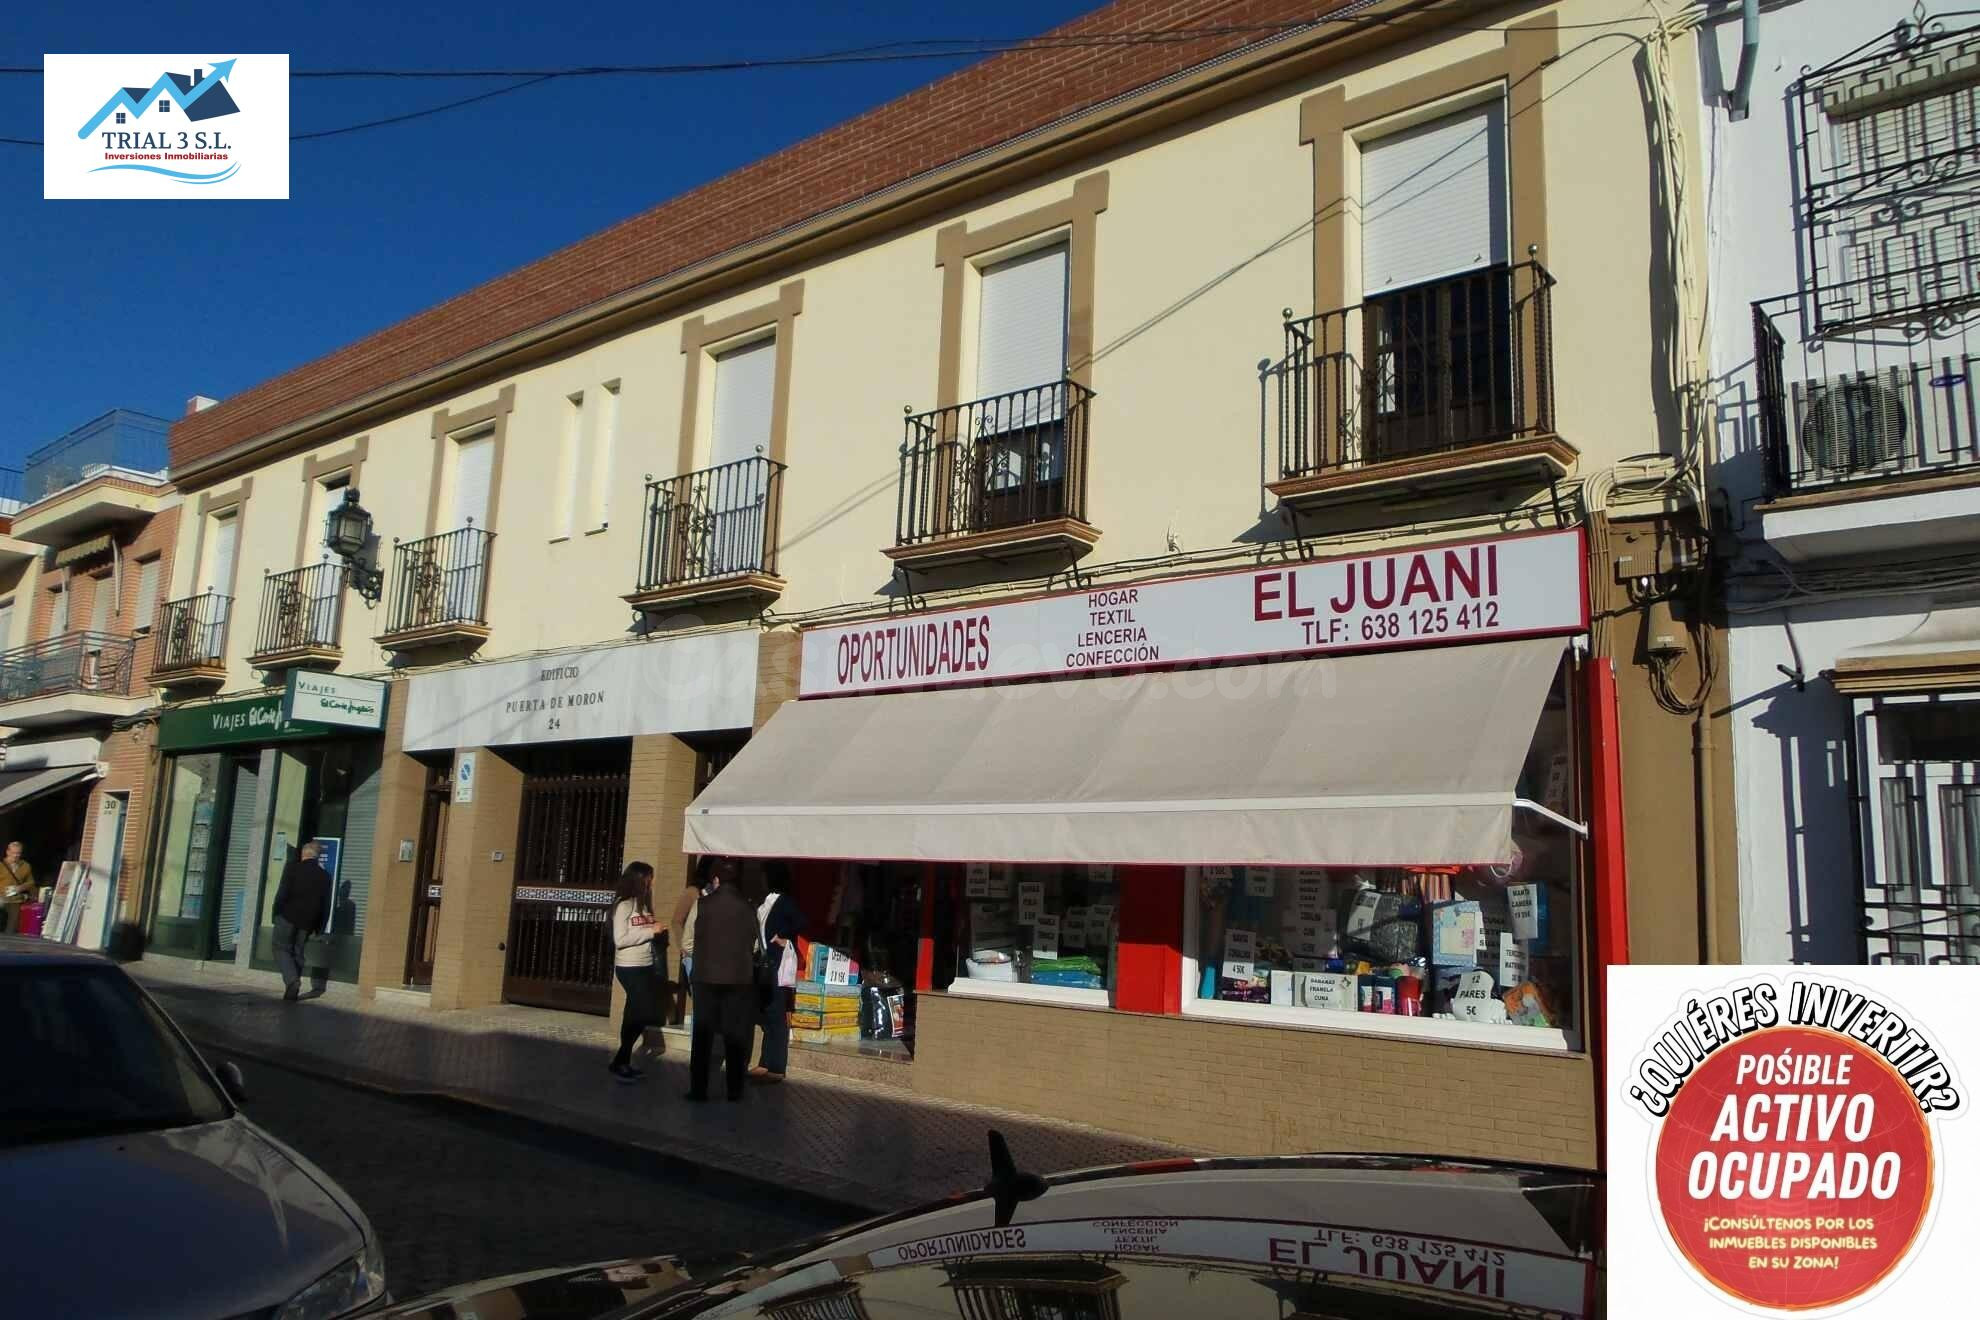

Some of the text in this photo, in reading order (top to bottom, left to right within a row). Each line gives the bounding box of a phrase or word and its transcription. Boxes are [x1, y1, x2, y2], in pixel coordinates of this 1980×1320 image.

[1254, 545, 1498, 621] EL JUANI
[1088, 589, 1138, 608] HOGAR
[1089, 608, 1136, 626] TEXTIL
[1301, 601, 1499, 645] TLF: 638 125 412
[1078, 627, 1147, 647] LENCERIA
[837, 615, 990, 685] OPORTUNIDADES
[1066, 643, 1159, 668] CONFECCIÓN
[541, 666, 579, 681] EDIFICIO
[298, 681, 336, 694] VIAJES
[505, 690, 605, 713] PUERTA DE MORON
[212, 713, 246, 732] VIAJES
[548, 718, 560, 730] 24
[104, 800, 116, 809] 30
[1459, 989, 1486, 999] PARES
[1465, 1005, 1477, 1016] 5€
